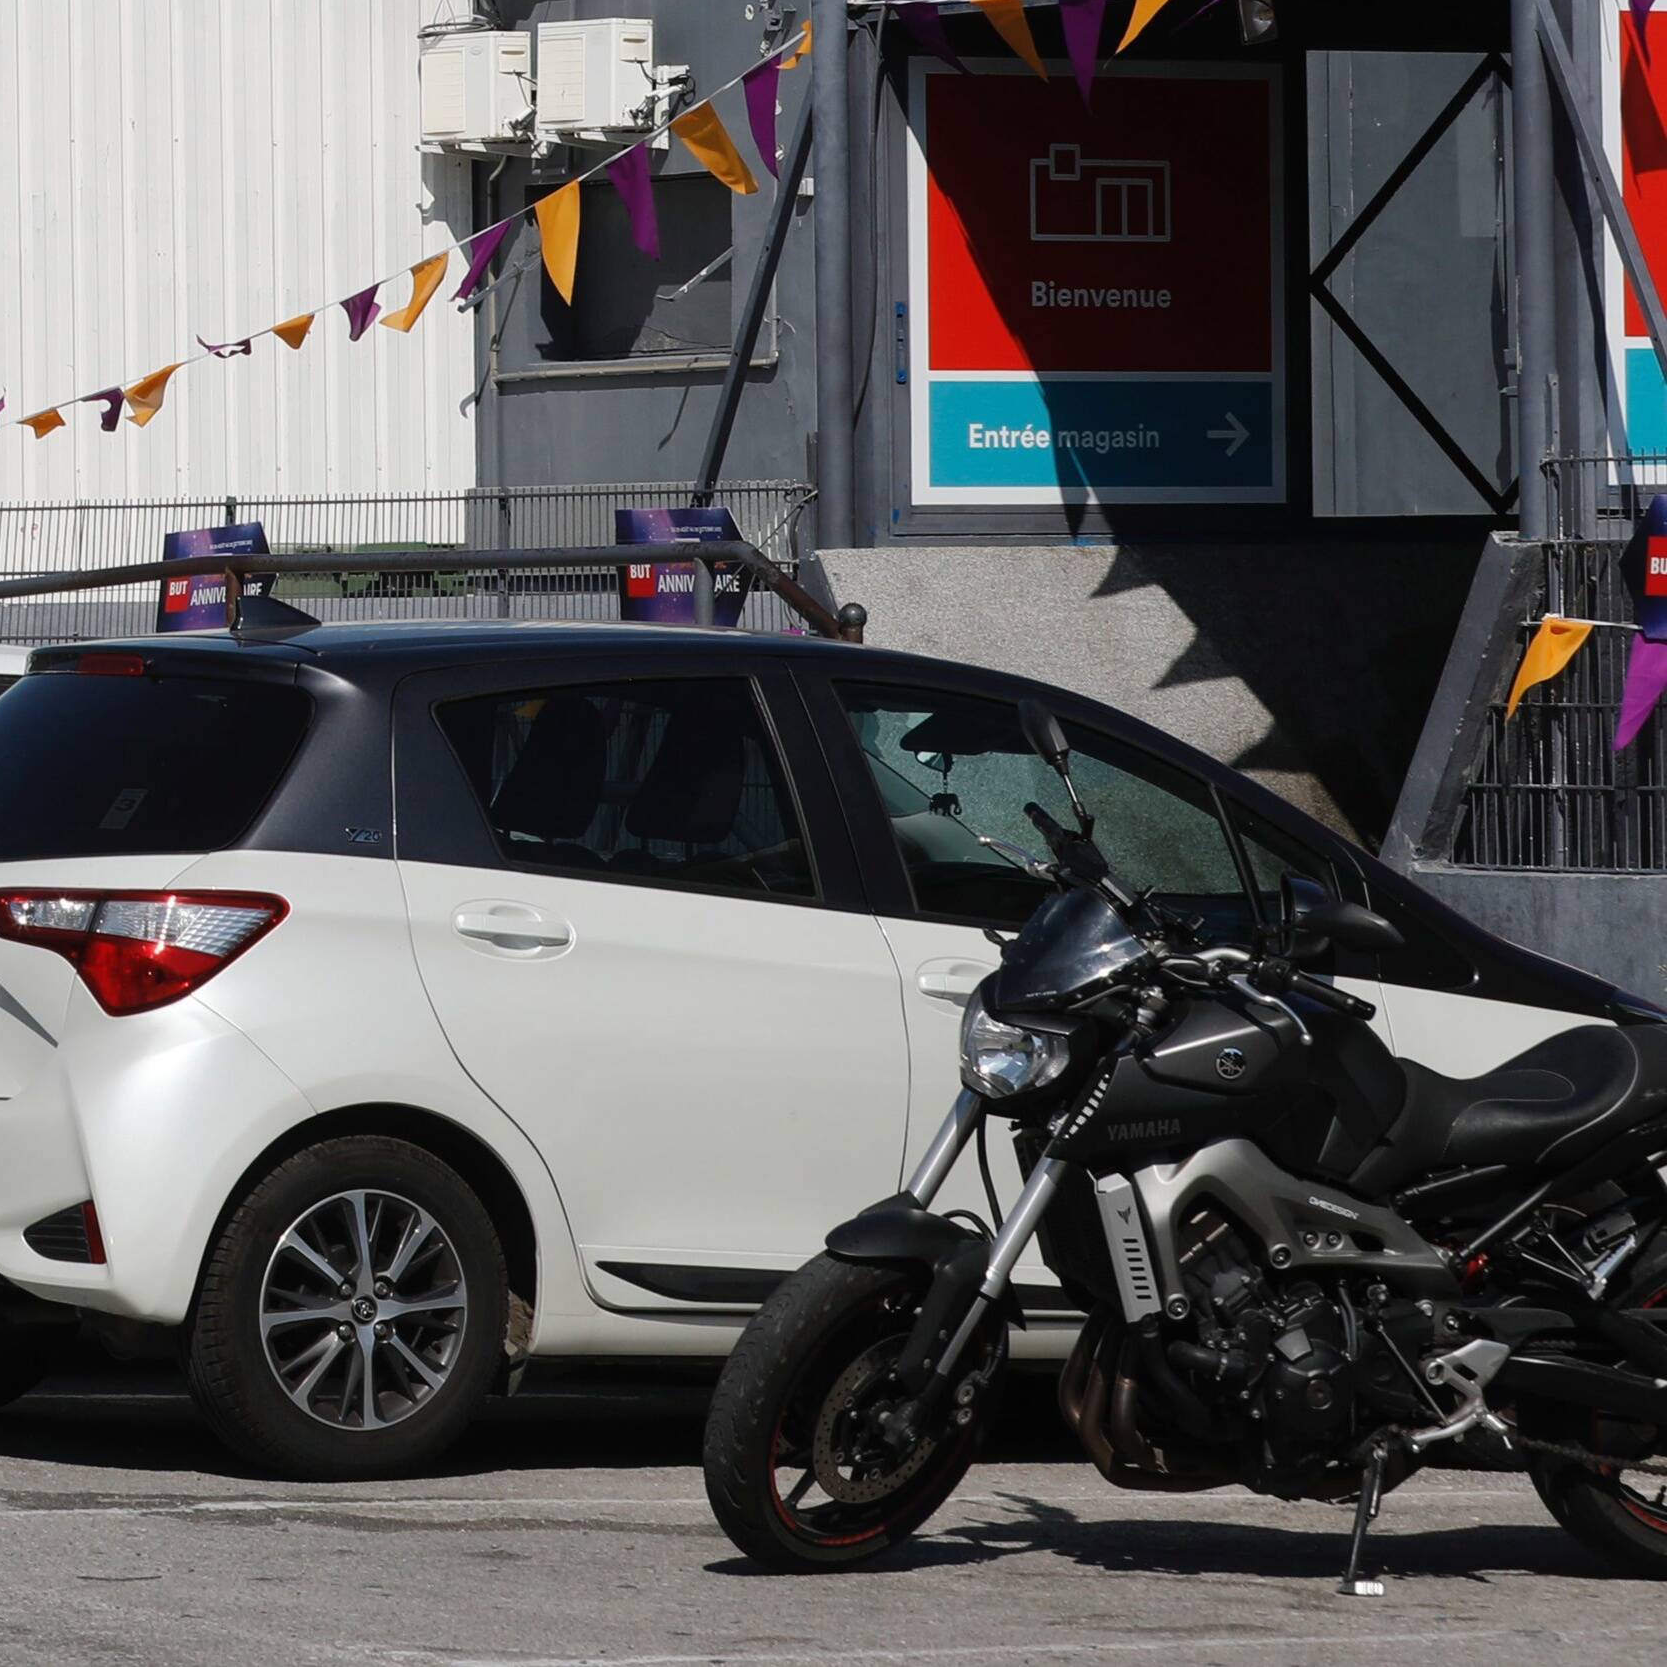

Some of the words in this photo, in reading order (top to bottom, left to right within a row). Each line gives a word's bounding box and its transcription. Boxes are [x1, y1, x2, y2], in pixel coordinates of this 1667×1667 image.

[1030, 280, 1172, 309] Bienvenue
[969, 423, 1051, 449] Entrée
[1058, 423, 1160, 455] magasin
[630, 563, 651, 579] BUT
[1650, 556, 1667, 575] BU
[169, 580, 188, 596] BUT
[1107, 1118, 1182, 1141] YAMAHA
